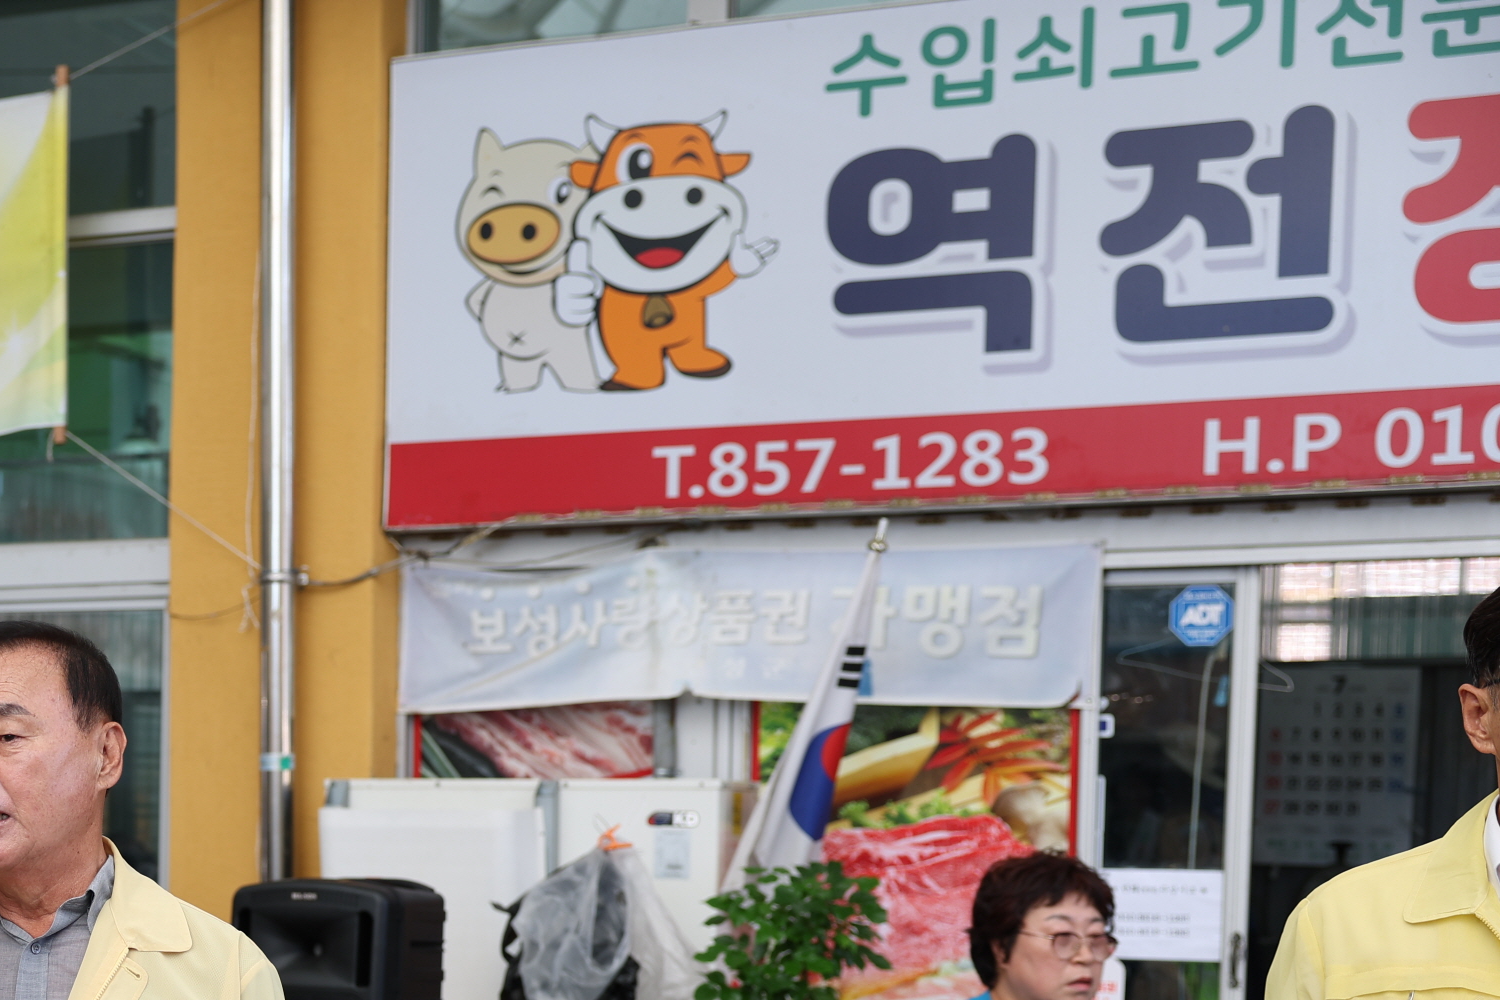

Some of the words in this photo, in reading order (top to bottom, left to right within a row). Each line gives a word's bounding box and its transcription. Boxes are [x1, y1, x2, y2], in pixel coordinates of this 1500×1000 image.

[652, 426, 1050, 500] T.857-1283
[1202, 412, 1343, 477] H.P
[464, 587, 811, 657] 보성사랑상품권
[1179, 603, 1225, 626] ADT
